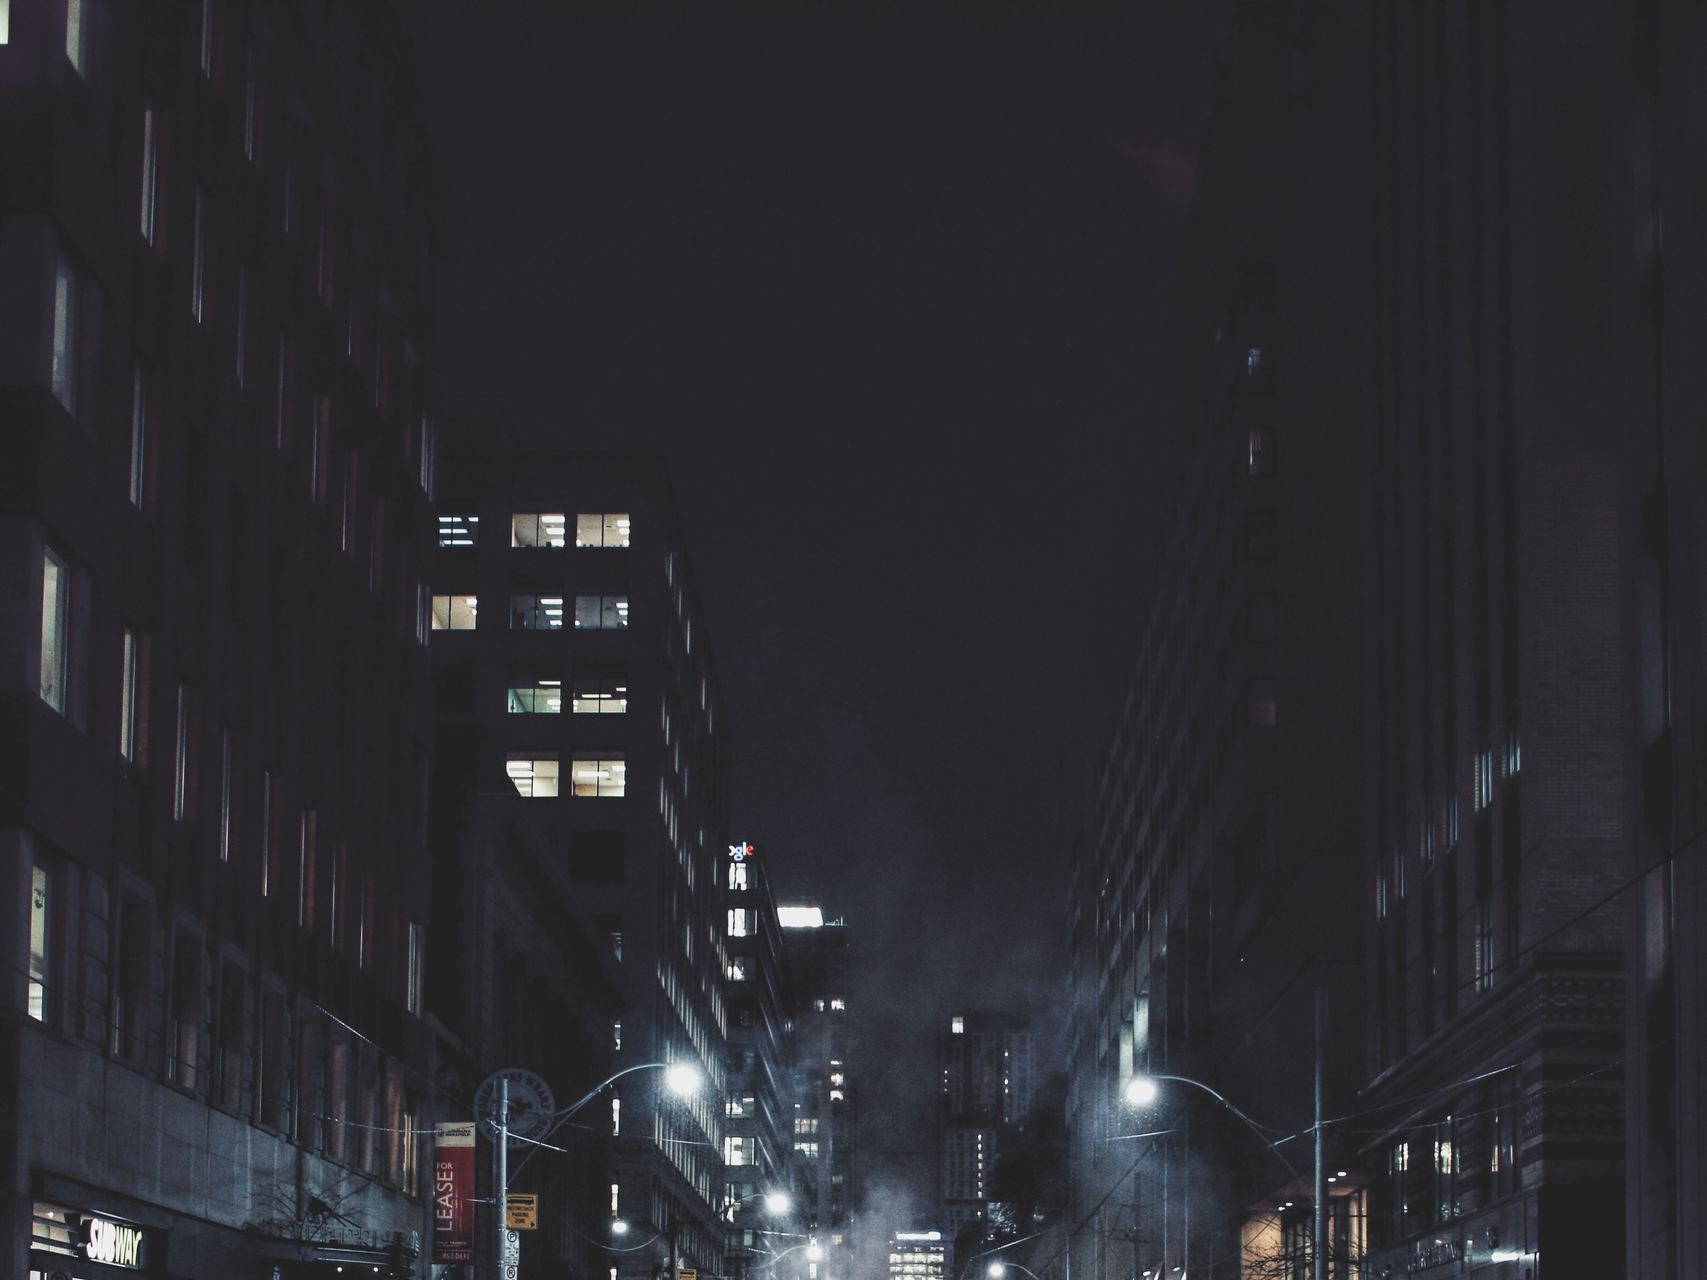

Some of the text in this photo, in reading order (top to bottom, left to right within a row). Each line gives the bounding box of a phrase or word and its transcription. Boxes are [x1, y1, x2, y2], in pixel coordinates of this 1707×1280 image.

[436, 1162, 453, 1170] FOR
[435, 1171, 454, 1231] LEASE
[86, 1217, 143, 1266] SUBWAY
